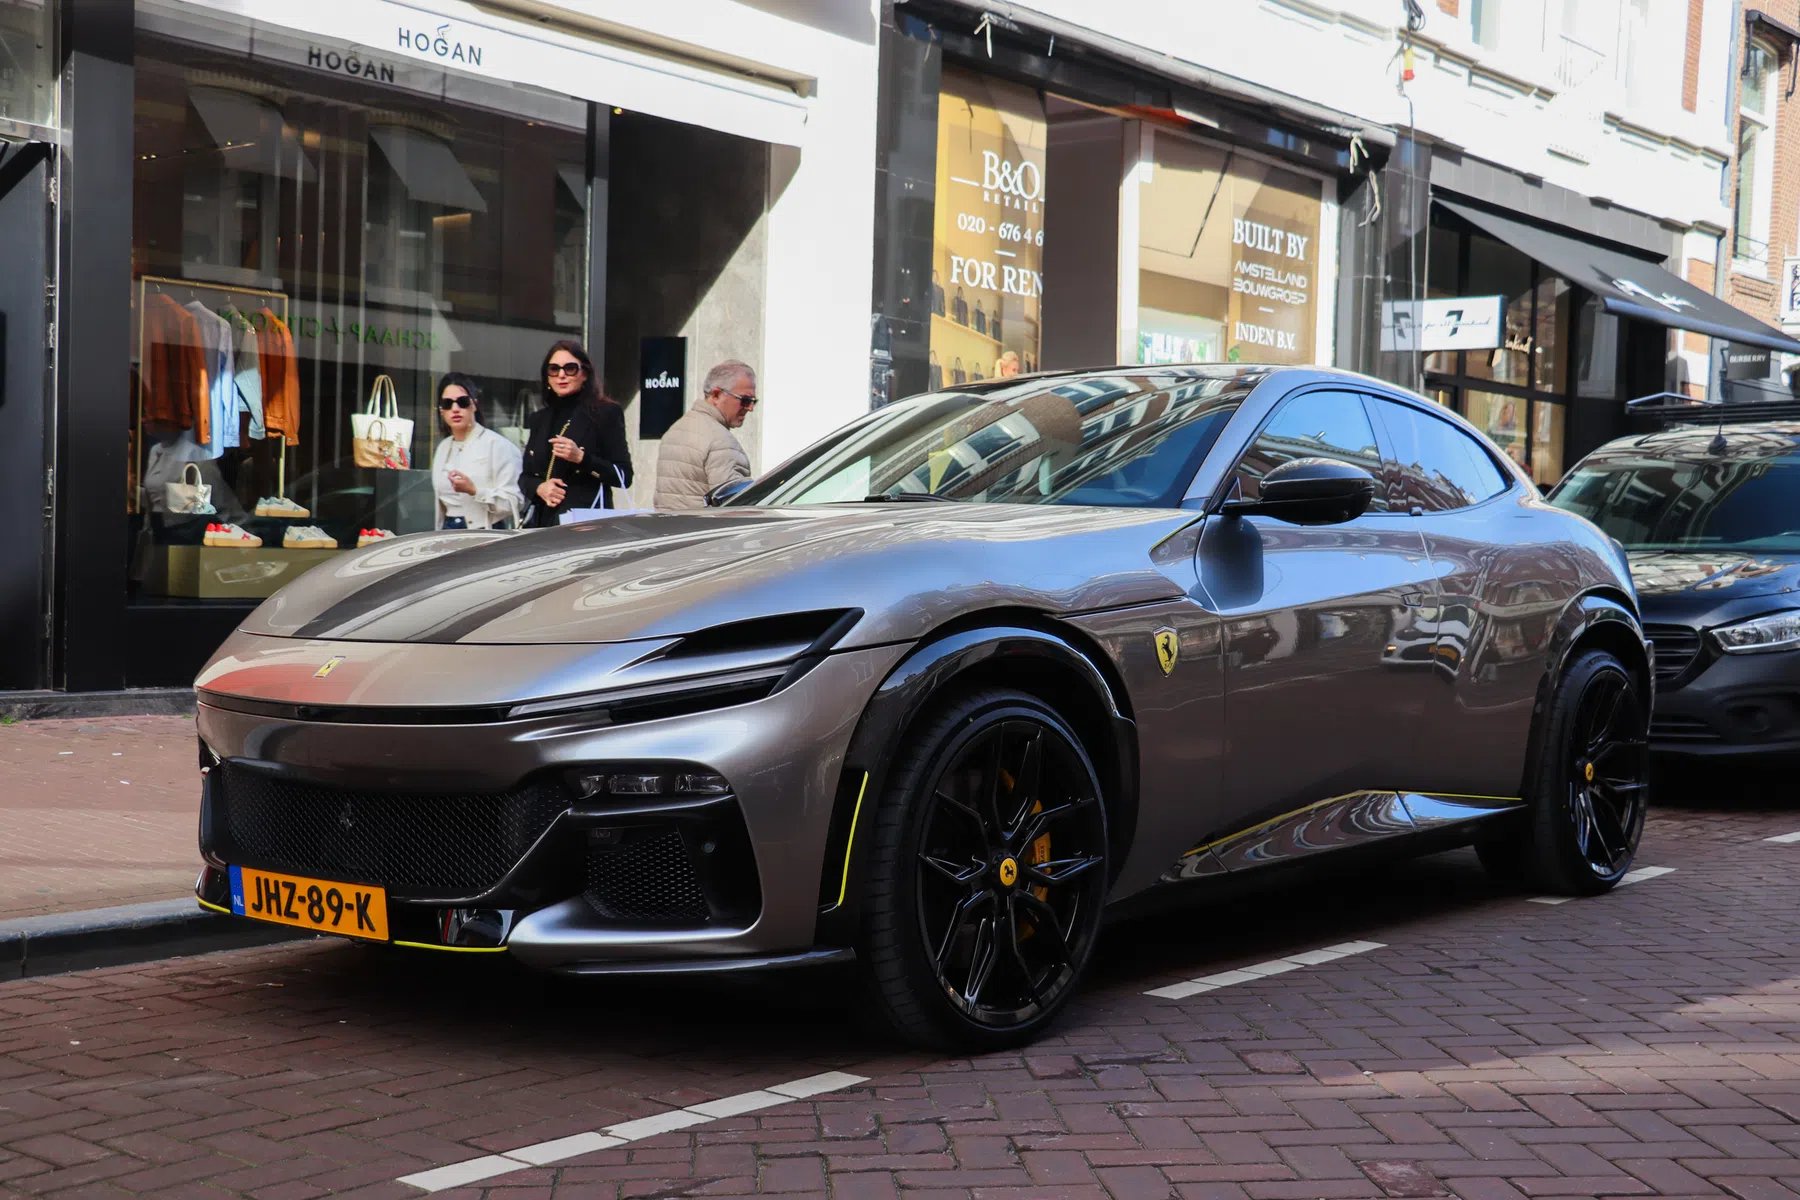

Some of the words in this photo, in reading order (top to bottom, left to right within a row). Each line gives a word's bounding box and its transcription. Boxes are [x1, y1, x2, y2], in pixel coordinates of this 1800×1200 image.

[398, 26, 482, 66] HOGAN
[308, 46, 395, 83] HOGAN
[982, 150, 1040, 200] B&O
[983, 190, 1039, 213] RETAIL
[957, 213, 986, 234] 020
[998, 222, 1021, 242] 676
[1233, 218, 1283, 255] BUILT
[1286, 232, 1308, 260] BY
[950, 255, 998, 290] FOR
[1234, 260, 1307, 289] AMSTELLAND
[1232, 277, 1307, 305] BOUWGROEP
[1235, 321, 1275, 347] INDEN
[1277, 330, 1297, 351] B.V.
[645, 376, 680, 389] HOGAN
[233, 894, 244, 907] NL
[252, 876, 376, 932] JHZ-89-K
